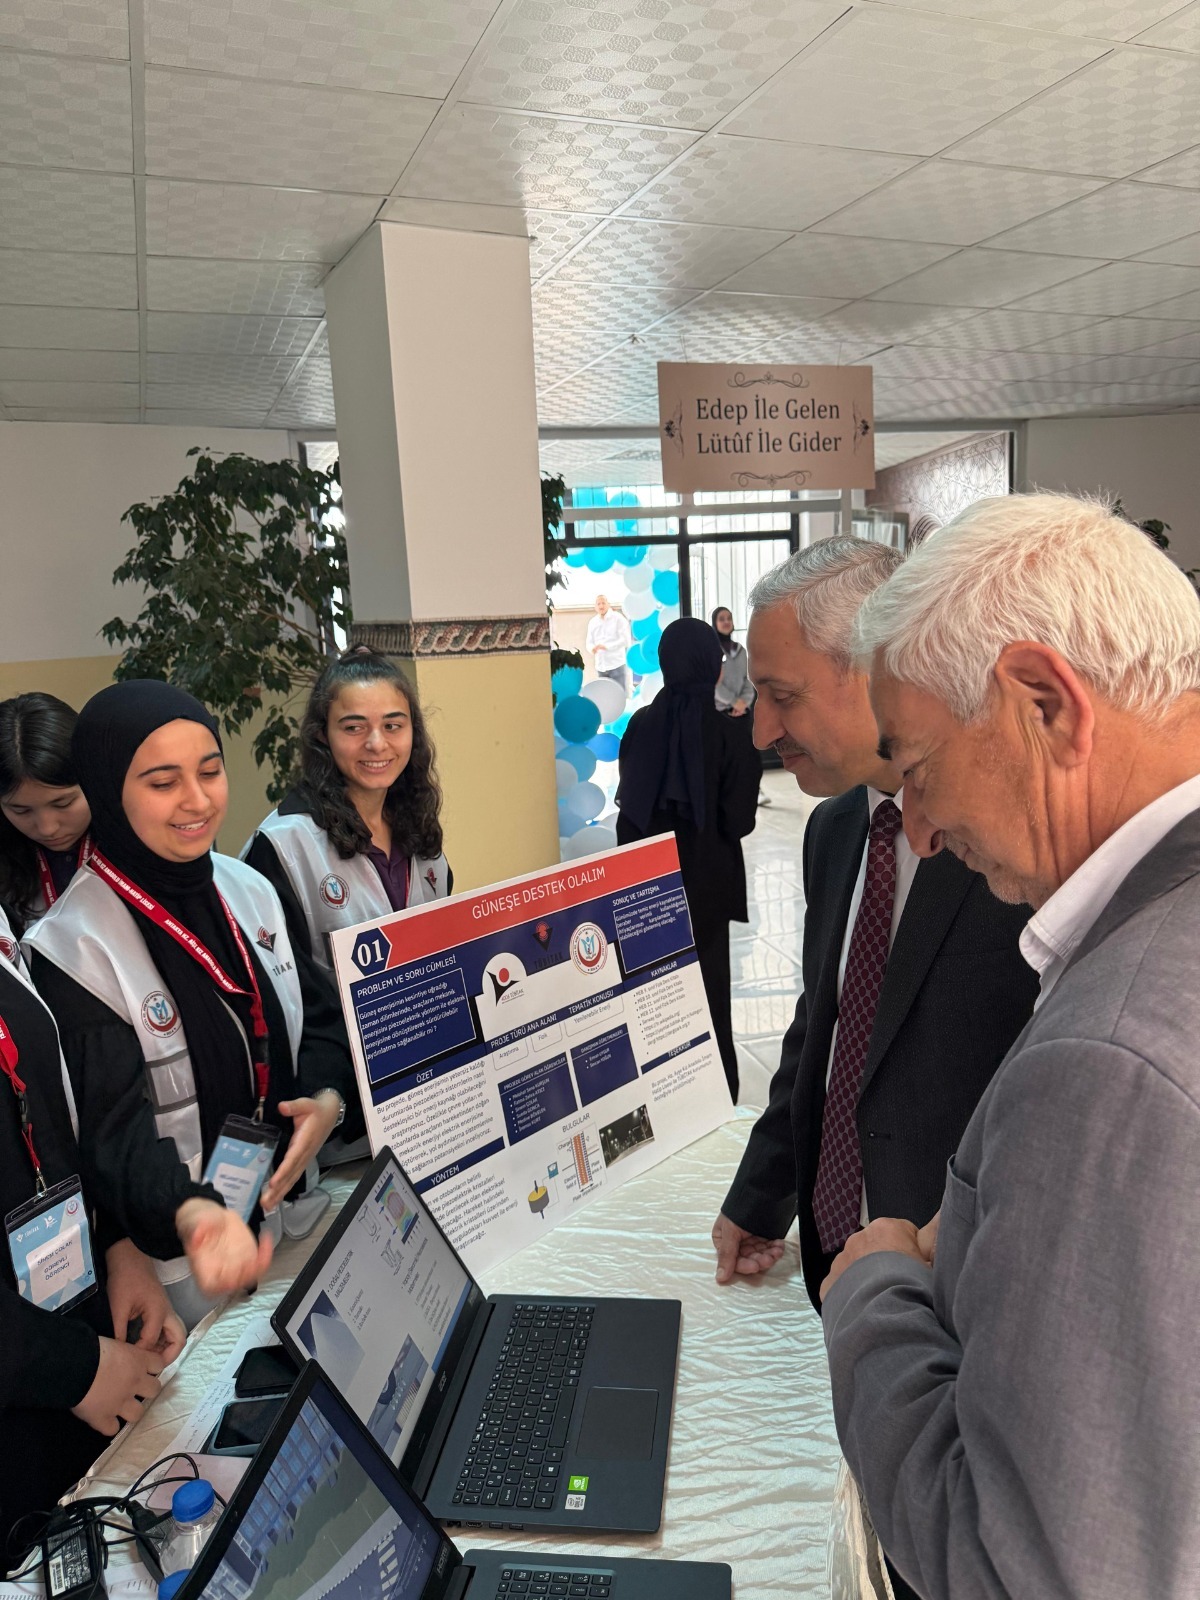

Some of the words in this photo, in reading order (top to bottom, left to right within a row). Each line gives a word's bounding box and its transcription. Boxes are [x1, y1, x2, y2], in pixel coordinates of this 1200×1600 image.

[696, 398, 748, 425] Edep
[755, 394, 779, 420] İle
[785, 398, 840, 420] Gelen
[697, 431, 753, 454] Lütûf
[758, 428, 782, 453] İle
[789, 431, 842, 452] Gider
[471, 891, 520, 922] GÜNEŞE
[522, 879, 566, 903] DESTEK
[566, 866, 605, 888] OLALIM
[612, 896, 629, 907] SONUÇ
[636, 885, 660, 898] TARTIŞMA
[355, 939, 384, 967] 01
[357, 979, 393, 997] PROBLEM
[394, 974, 403, 984] VE
[405, 967, 424, 980] SORU
[425, 954, 456, 972] CÜMLESİ
[650, 961, 677, 976] KAYNAKLAR
[360, 1009, 377, 1020] Güneş
[377, 998, 404, 1013] enerjisinin
[405, 990, 427, 1002] kesintiye
[427, 981, 448, 994] uğradığı
[361, 1019, 379, 1030] zaman
[412, 997, 434, 1010] araçların
[435, 989, 455, 1000] mekanik
[568, 998, 591, 1014] TEMATİK
[592, 990, 613, 1003] KONUSU
[598, 1002, 610, 1013] Enerji
[363, 1026, 387, 1040] enerjisini
[388, 1013, 420, 1030] piezoelektrik
[421, 1006, 440, 1017] yöntem
[447, 994, 465, 1005] elektrik
[490, 1034, 509, 1048] PROJE
[510, 1026, 526, 1039] TÜRÜ
[527, 1021, 539, 1032] ANA
[540, 1014, 557, 1025] ALANI
[365, 1035, 391, 1050] enerjisine
[391, 1021, 425, 1038] dönüştürerek
[367, 1043, 396, 1060] aydınlatma
[396, 1030, 426, 1047] sağlanabilir
[407, 1089, 423, 1101] güneş
[423, 1076, 449, 1092] enerjisinin
[449, 1068, 469, 1080] yetersiz
[469, 1060, 485, 1071] kaldığı
[416, 1068, 434, 1082] ÖZET
[381, 1104, 412, 1122] durumlarda
[412, 1088, 445, 1108] piezoelektrik
[445, 1075, 473, 1092] sistemlerin
[473, 1070, 484, 1079] nasıl
[383, 1113, 414, 1132] destekleyici
[422, 1102, 437, 1114] enerji
[437, 1093, 456, 1107] kaynağı
[457, 1079, 486, 1097] olabileceğini
[447, 1102, 461, 1113] çevre
[391, 1132, 419, 1150] tobanlarda
[442, 1105, 475, 1124] hareketinden
[475, 1098, 489, 1109] doğan
[399, 1142, 421, 1157] mekanik
[422, 1133, 441, 1146] enerjiyi
[441, 1123, 460, 1135] elektrik
[460, 1112, 483, 1127] enerjisine
[562, 1113, 590, 1132] BULGULAR
[401, 1150, 428, 1167] üştürerek,
[428, 1144, 437, 1153] yol
[437, 1131, 464, 1149] aydınlatma
[465, 1117, 493, 1134] sistemlerine
[430, 1164, 459, 1185] YÖNTEM
[441, 1187, 472, 1209] piezoelektrik
[472, 1174, 495, 1190] kristalleri
[445, 1199, 469, 1216] üretilecek
[470, 1192, 480, 1202] olan
[481, 1178, 505, 1195] elektriksel
[463, 1201, 482, 1215] Hareket
[483, 1188, 504, 1204] halindeki
[487, 1196, 509, 1212] üzerinden
[483, 1211, 499, 1224] kuvvet
